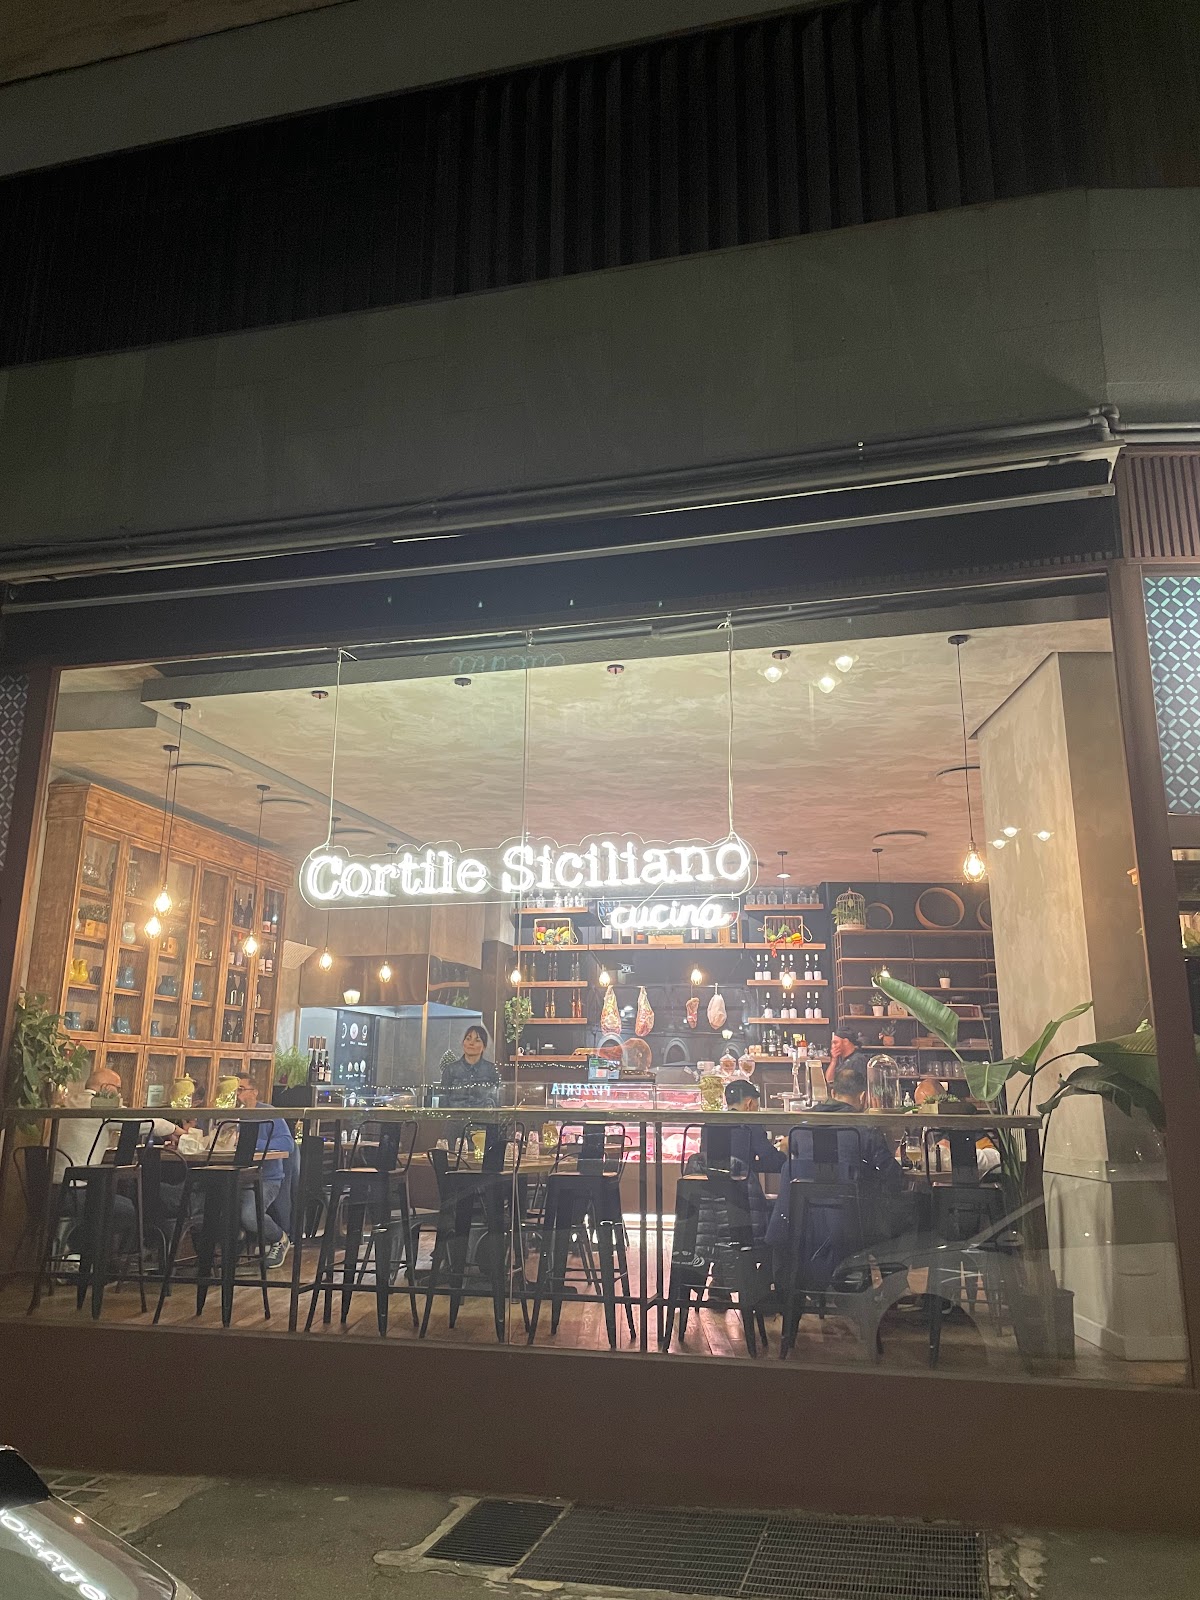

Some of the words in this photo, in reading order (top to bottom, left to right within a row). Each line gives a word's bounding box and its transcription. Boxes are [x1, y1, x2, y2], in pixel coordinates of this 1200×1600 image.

[306, 849, 489, 900] Cortile
[502, 841, 751, 893] Siciliano
[608, 900, 732, 929] cucina
